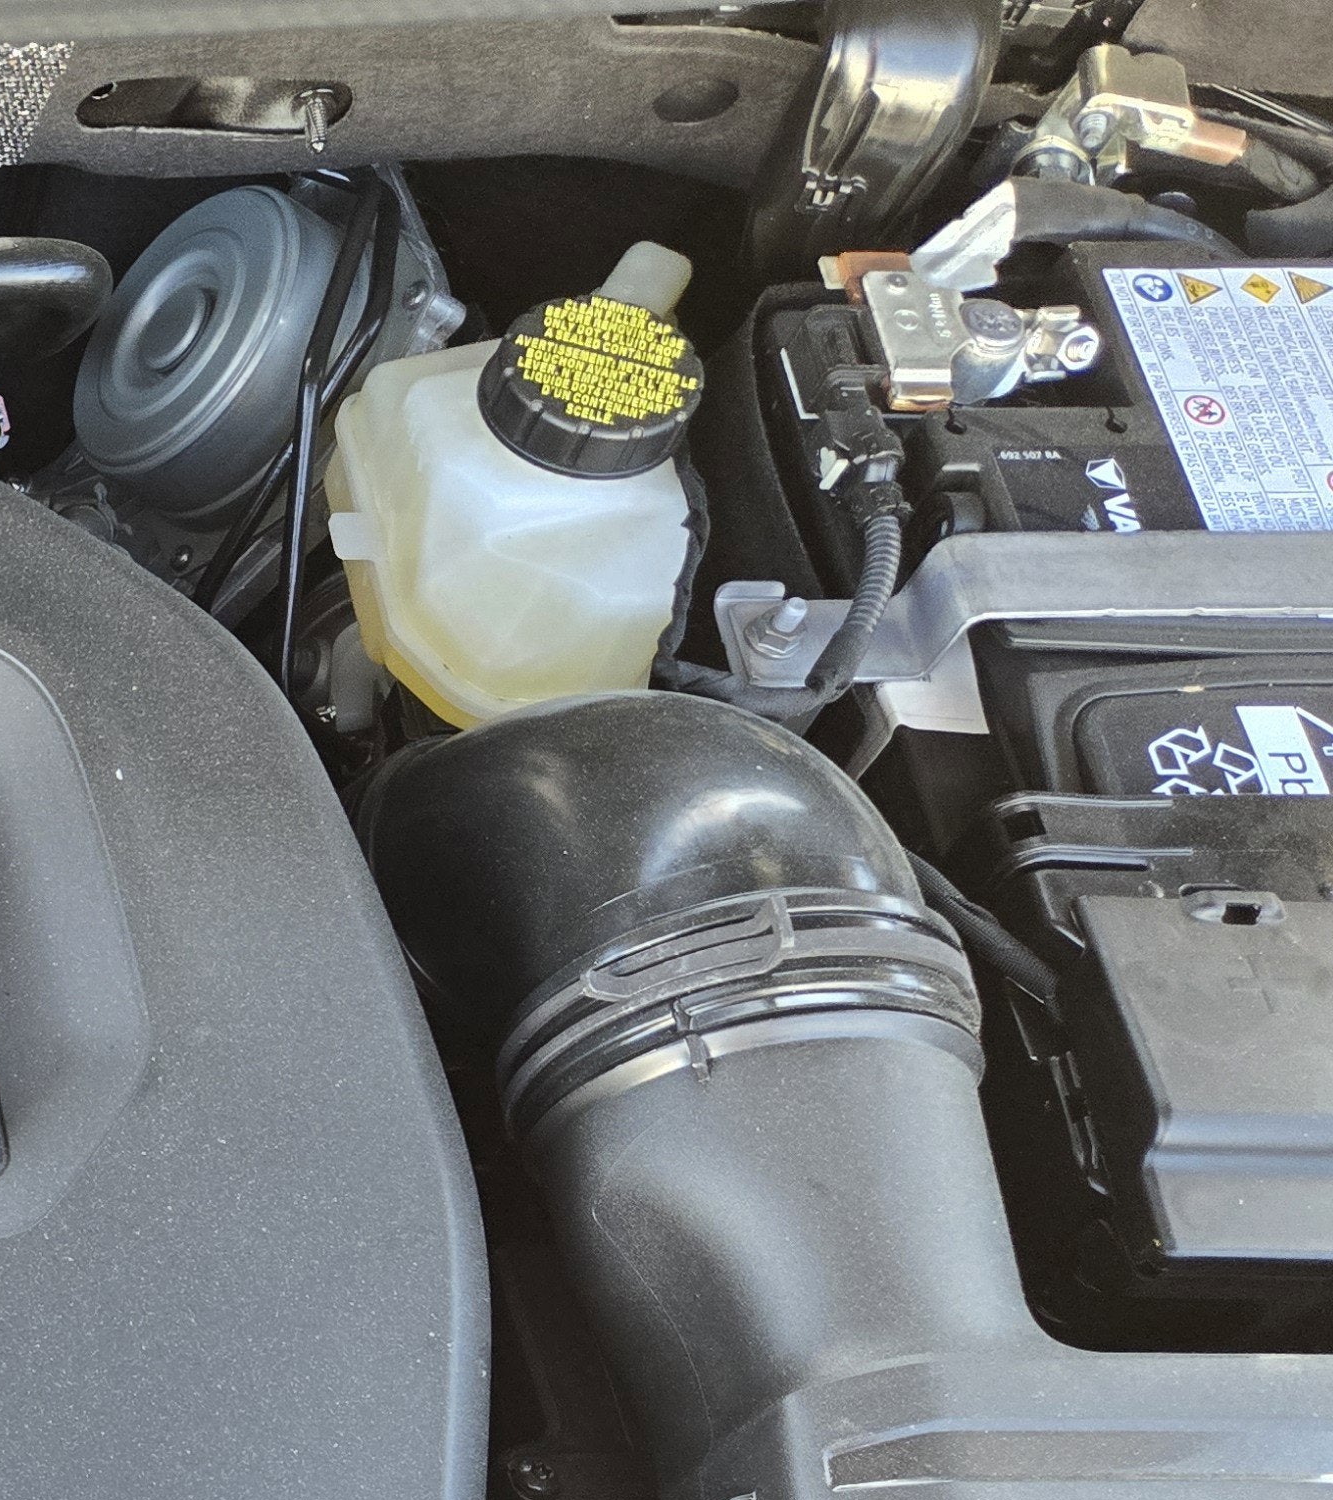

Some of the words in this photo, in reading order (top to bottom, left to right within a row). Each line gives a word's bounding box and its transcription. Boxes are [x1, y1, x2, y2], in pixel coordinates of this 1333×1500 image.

[562, 299, 606, 320] CLEAN
[603, 310, 647, 330] FILLER
[589, 296, 651, 320] WARNING:
[1204, 306, 1226, 329] CAUSE
[544, 316, 576, 334] ONLY
[576, 324, 602, 340] DOT
[601, 330, 611, 342] 4
[610, 333, 648, 352] FLUID
[647, 342, 683, 359] FROM
[545, 305, 593, 327] BEFORE
[659, 334, 686, 351] USE
[544, 328, 554, 338] A
[555, 329, 602, 350] SEALED
[601, 342, 676, 369] CONTAINER.
[526, 347, 585, 372] BOUCHON
[585, 362, 627, 383] AVANT
[616, 358, 681, 387] NETTOYER
[680, 377, 698, 390] LE
[1243, 362, 1262, 378] CAN
[523, 367, 571, 391] LIQUIDE
[600, 389, 672, 414] PROVENANT
[637, 386, 666, 404] QUE
[664, 393, 684, 408] DU
[1222, 385, 1240, 399] DES
[571, 391, 648, 419] CONTENANT
[1250, 416, 1267, 424] LA
[1149, 374, 1167, 388] PAS
[1182, 452, 1200, 467] PAS
[1202, 502, 1218, 511] LA
[1192, 431, 1209, 440] OF
[1207, 431, 1226, 446] THE
[1223, 431, 1244, 450] KEEP
[1214, 448, 1238, 474] REACH
[1232, 452, 1251, 469] OUT
[1240, 471, 1256, 481] OF
[1217, 491, 1236, 506] DES
[1232, 491, 1250, 501] DE
[1268, 752, 1314, 795] Pb
